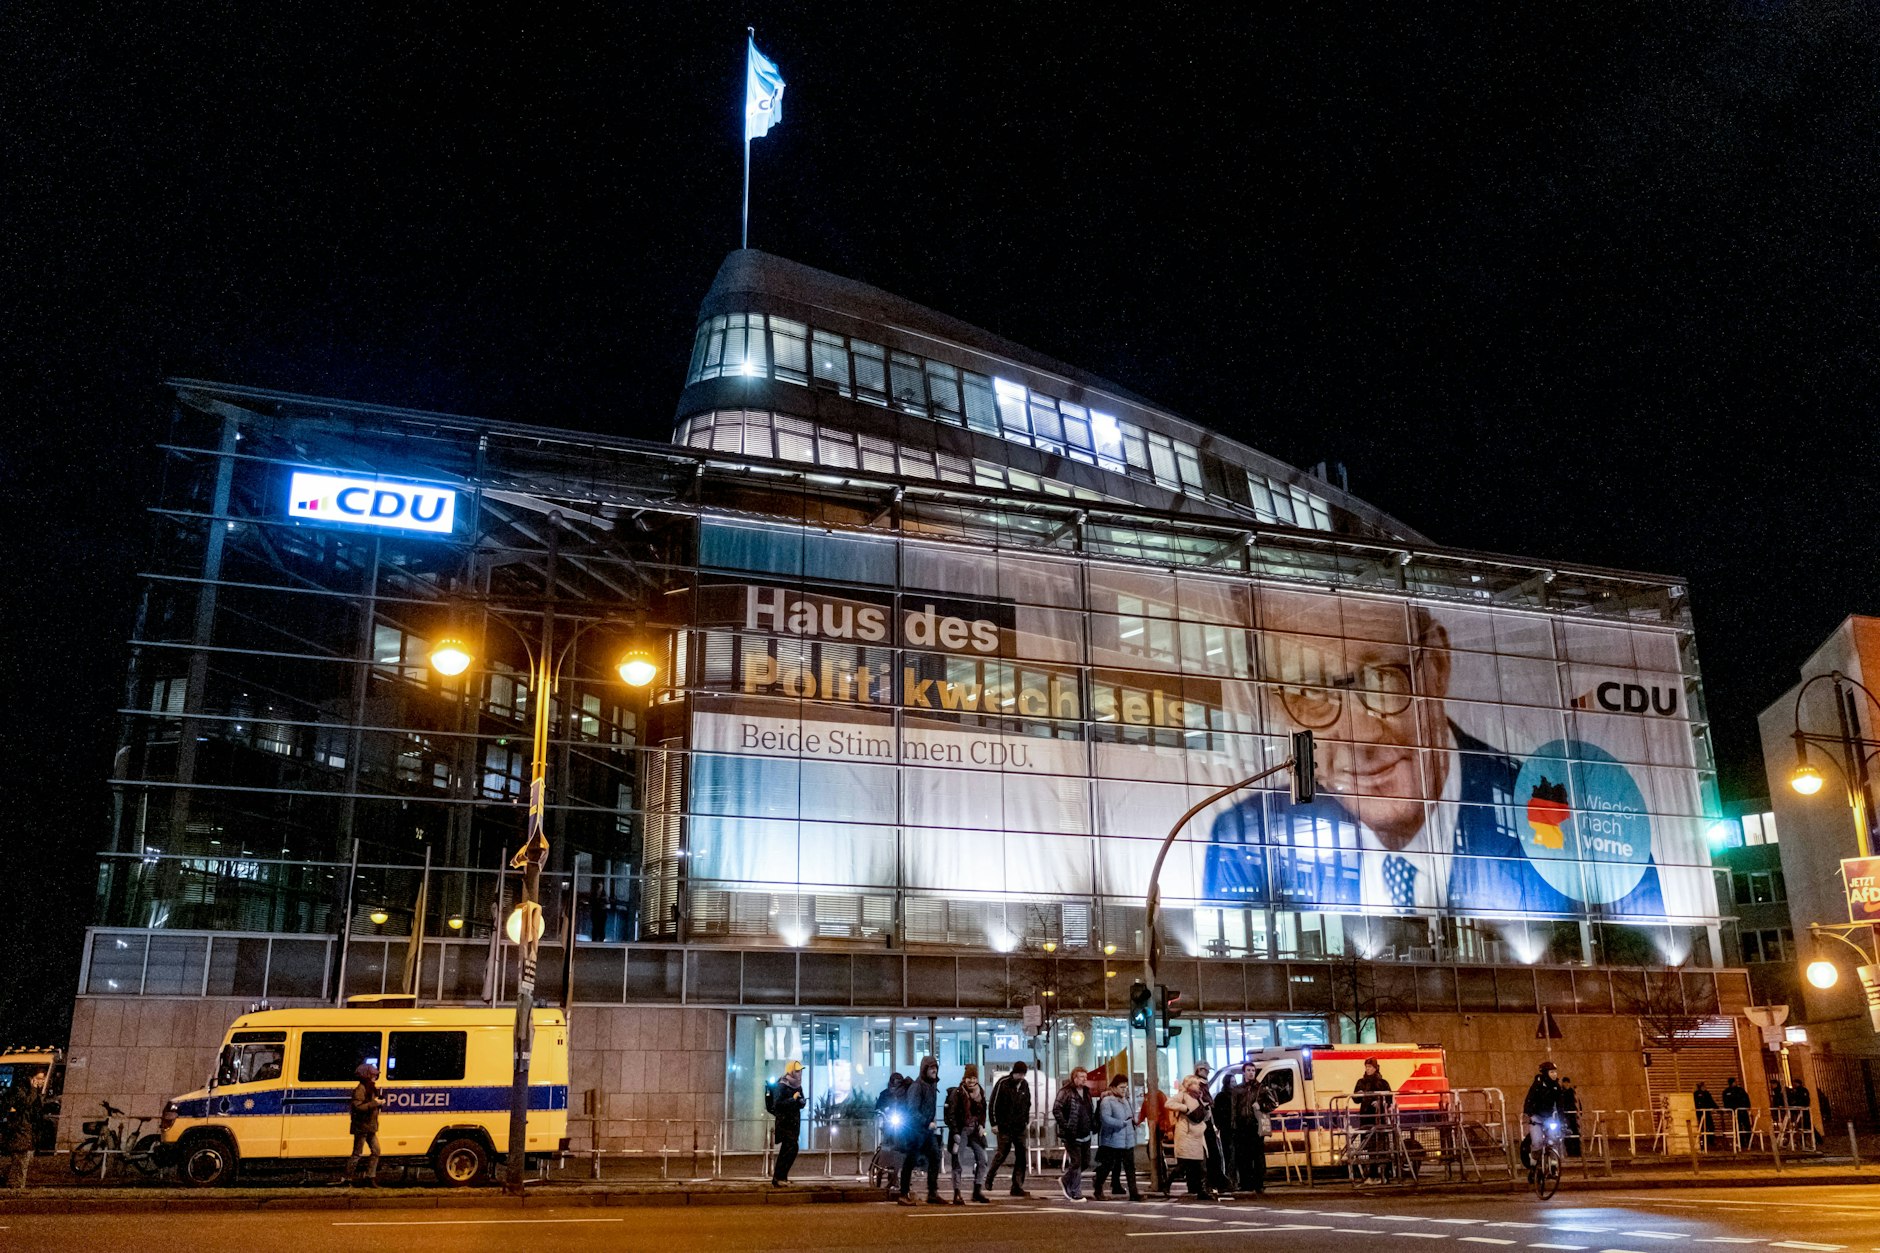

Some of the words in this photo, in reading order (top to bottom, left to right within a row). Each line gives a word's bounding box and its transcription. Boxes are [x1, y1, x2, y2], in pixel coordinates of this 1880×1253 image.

[336, 487, 447, 522] CDU
[746, 585, 887, 641] Haus
[904, 604, 999, 652] des
[744, 651, 1186, 728] Politikwechsels
[1596, 681, 1678, 716] CDU
[740, 723, 821, 753] Beide
[827, 730, 964, 764] Stimmen
[969, 740, 1034, 768] CDU.
[1583, 795, 1639, 821] Wieder
[1582, 815, 1622, 836] nach
[1582, 834, 1633, 857] vorne
[1849, 876, 1875, 888] JETZT
[1850, 886, 1880, 904] AfD
[386, 1093, 450, 1107] POLIZEI
